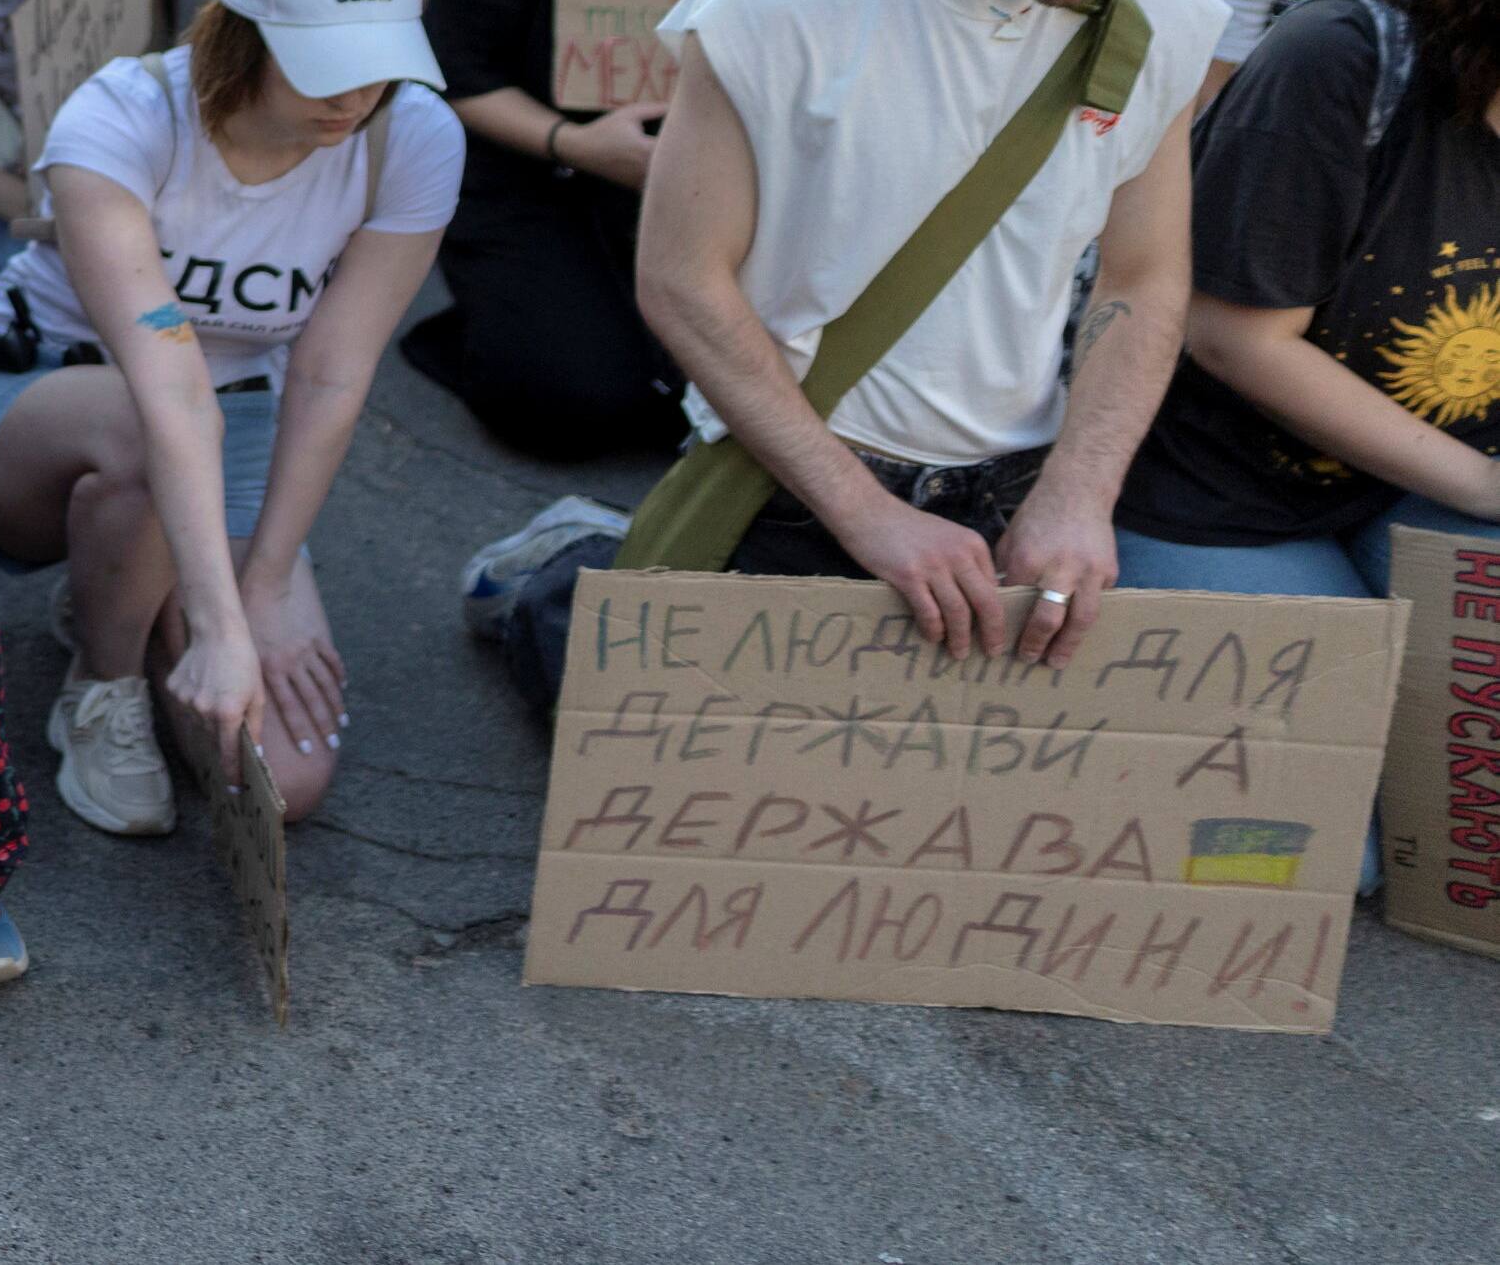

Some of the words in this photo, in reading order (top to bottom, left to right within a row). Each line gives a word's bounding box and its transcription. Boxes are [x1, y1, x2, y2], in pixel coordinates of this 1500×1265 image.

[161, 248, 334, 315] ДСМ
[596, 597, 706, 672] НЕ
[1095, 626, 1317, 713] ДЛЯ
[1175, 724, 1251, 793] А
[562, 784, 1153, 883] ДЕРЖАВА
[566, 877, 763, 953] ДЛЯ
